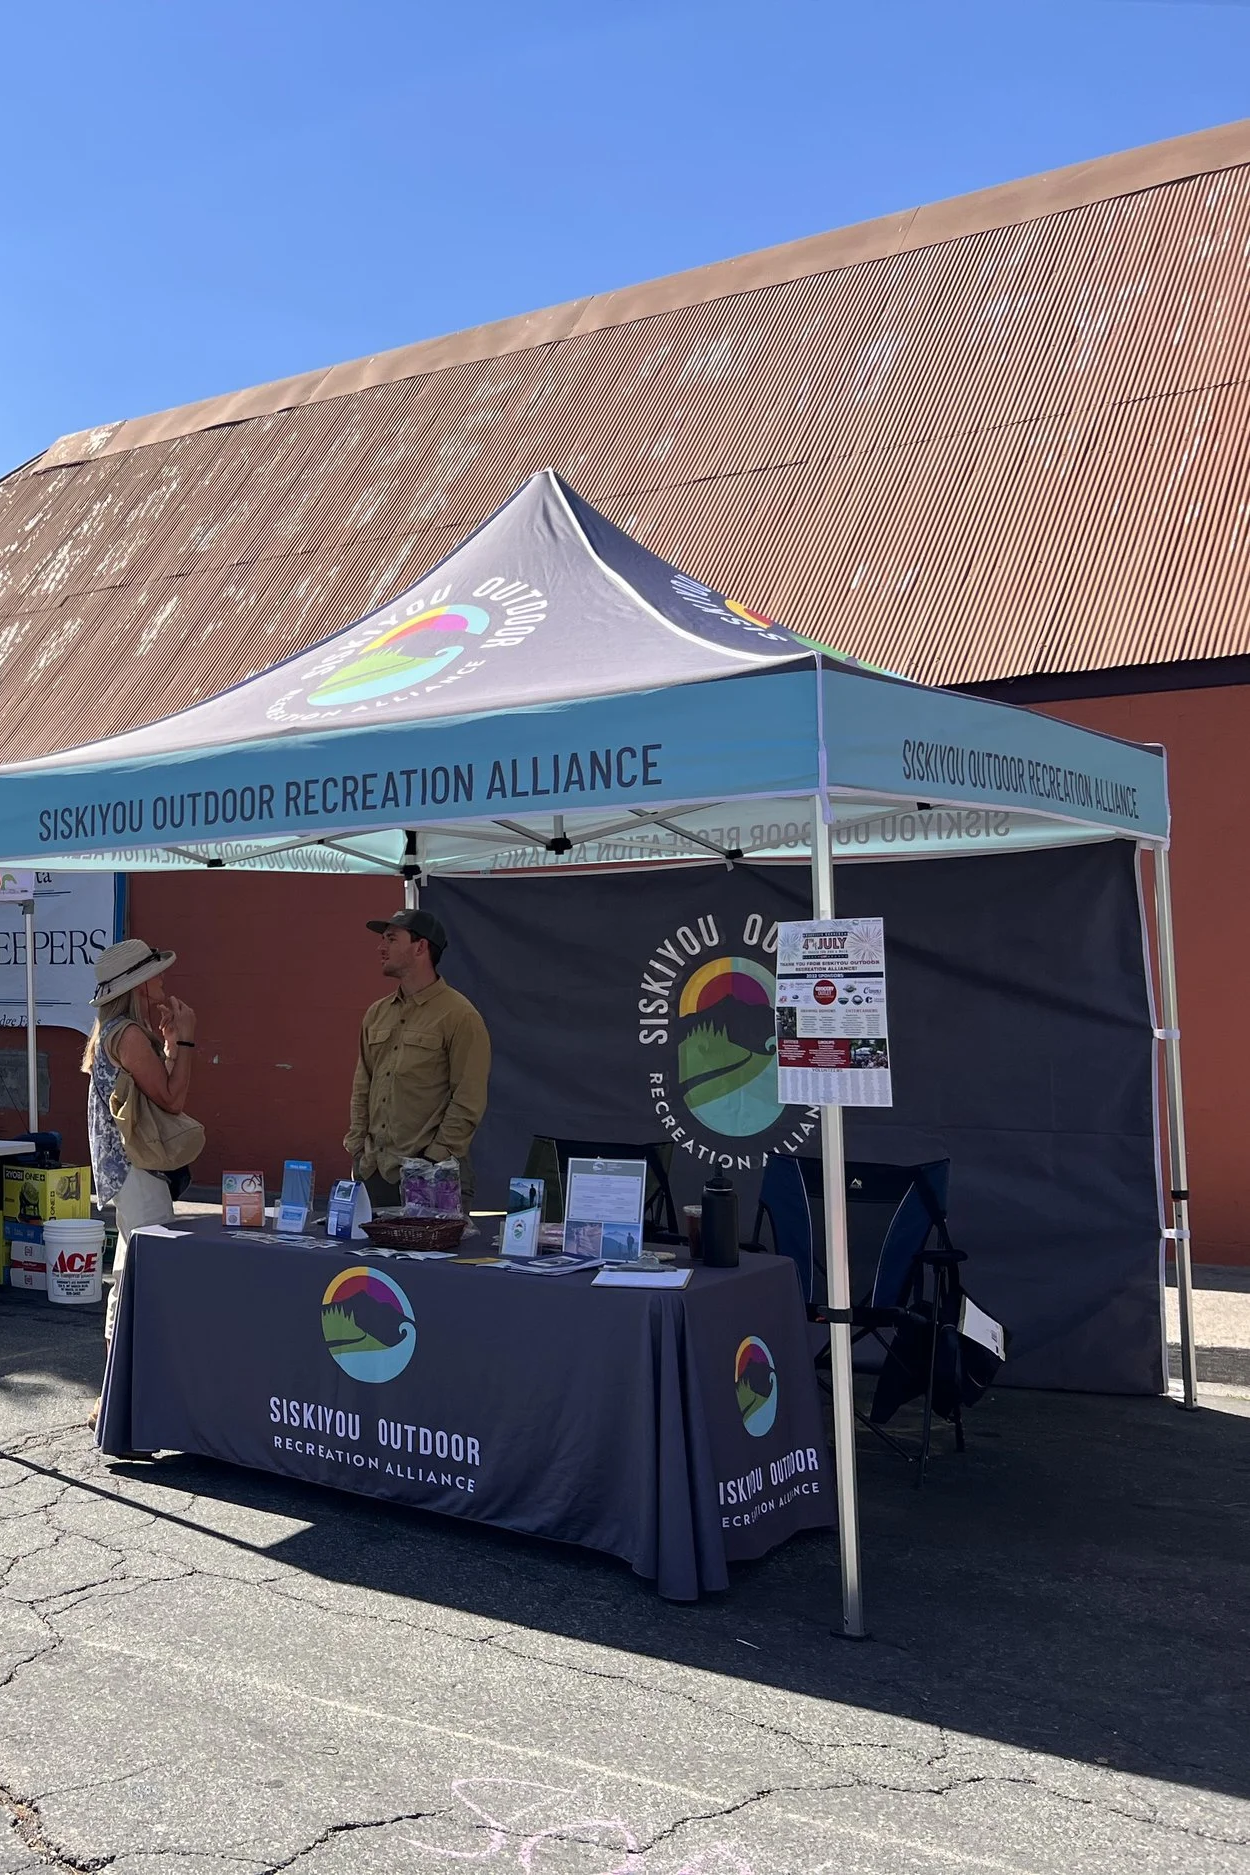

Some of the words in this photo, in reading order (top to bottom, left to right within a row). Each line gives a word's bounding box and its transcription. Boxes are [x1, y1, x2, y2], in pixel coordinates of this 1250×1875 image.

[472, 576, 550, 649] OUTDOOR
[38, 799, 144, 842] SISKIYOU
[152, 783, 275, 831] OUTDOOR
[285, 763, 473, 817] RECREATION
[486, 743, 663, 800] ALLIANCE
[902, 738, 965, 786] SISKIYOU
[968, 750, 1027, 794] OUTDOOR
[1028, 760, 1093, 808] RECREATION
[1095, 778, 1139, 819] ALLIANCE
[817, 937, 847, 950] JULY
[638, 914, 720, 1045] SISKIYOU
[650, 1072, 751, 1171] RECREATION
[6, 1170, 23, 1180] RYOBI
[52, 1250, 98, 1273] ACE
[269, 1396, 361, 1441] SISKIYOU
[377, 1418, 481, 1466] OUTDOOR
[273, 1435, 380, 1470] RECREATION
[385, 1462, 476, 1494] ALLIANCE
[718, 1466, 763, 1506] ISKIYOU
[769, 1447, 819, 1486] OUTDOOR
[722, 1499, 775, 1528] ECREATION
[778, 1482, 820, 1508] ALLIANCE
